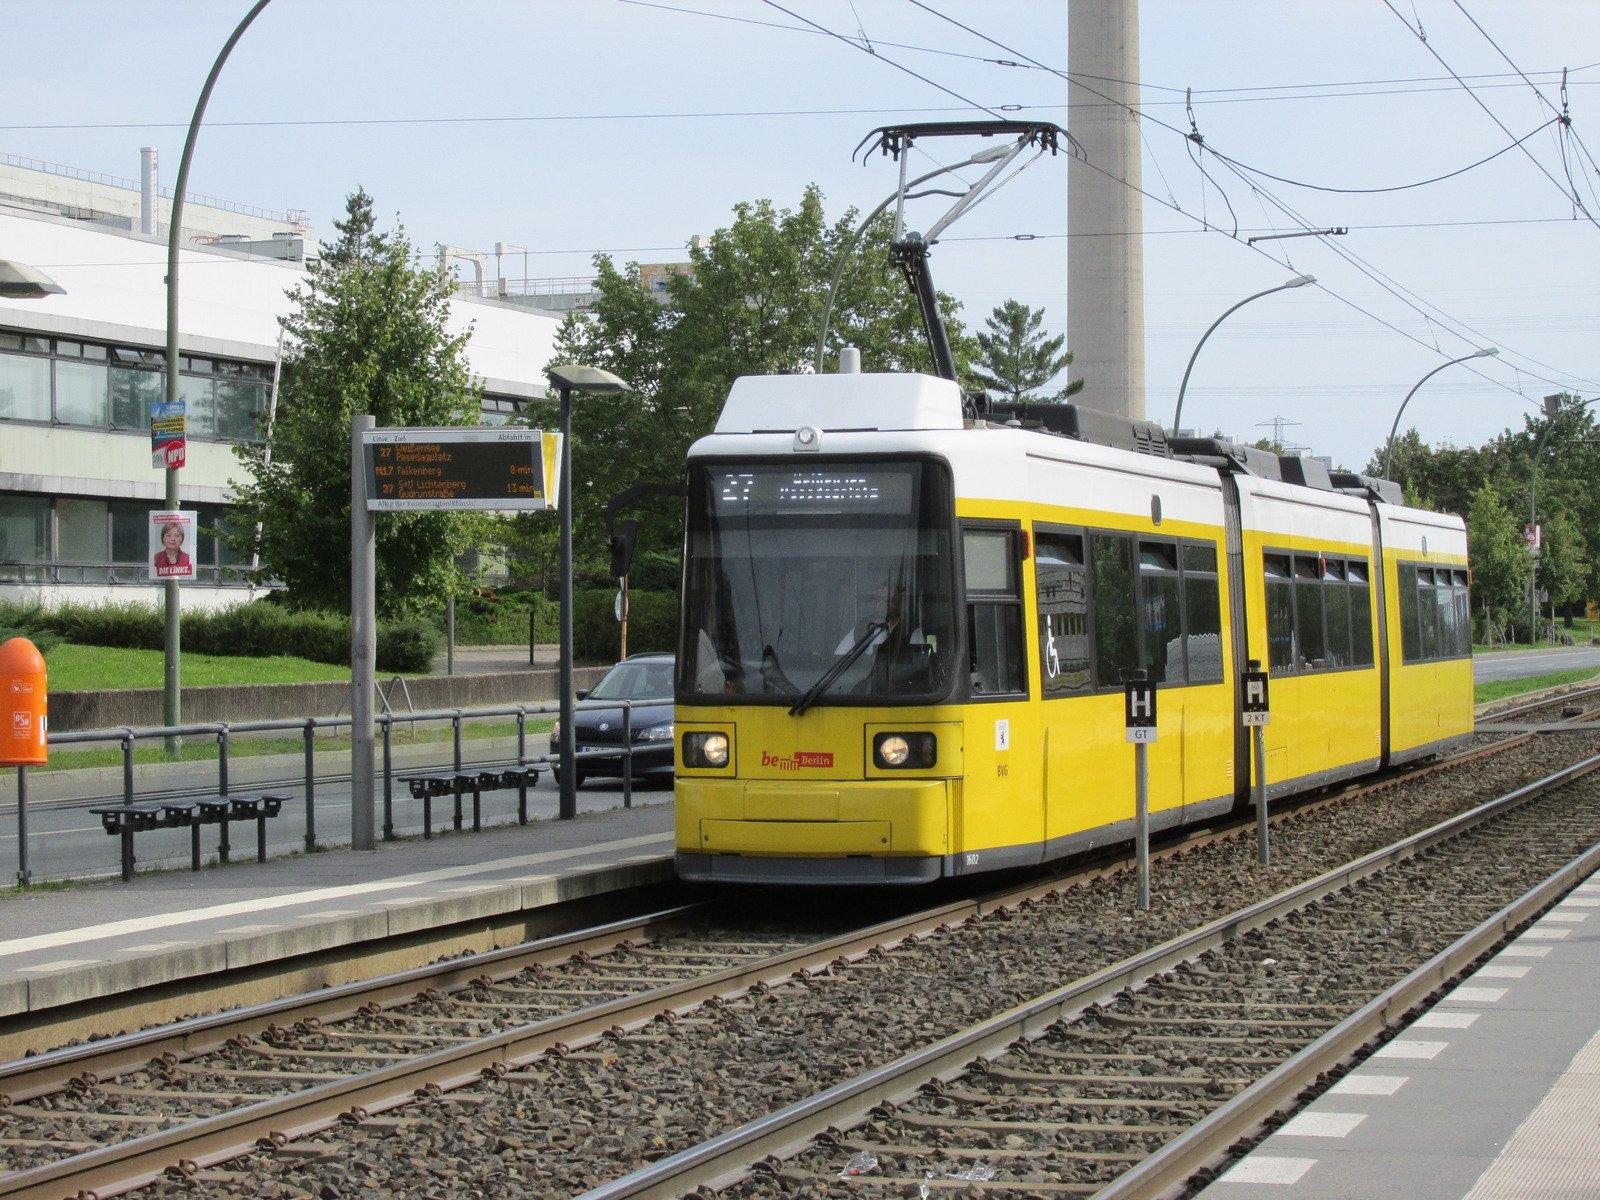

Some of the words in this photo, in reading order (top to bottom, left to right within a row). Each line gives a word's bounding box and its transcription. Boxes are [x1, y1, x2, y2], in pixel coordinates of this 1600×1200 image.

[168, 447, 184, 463] NPD
[380, 448, 391, 458] 27
[723, 474, 753, 500] 27
[159, 567, 169, 575] DIE
[1131, 688, 1151, 717] H
[1134, 729, 1149, 739] GT
[802, 755, 830, 765] Berlin
